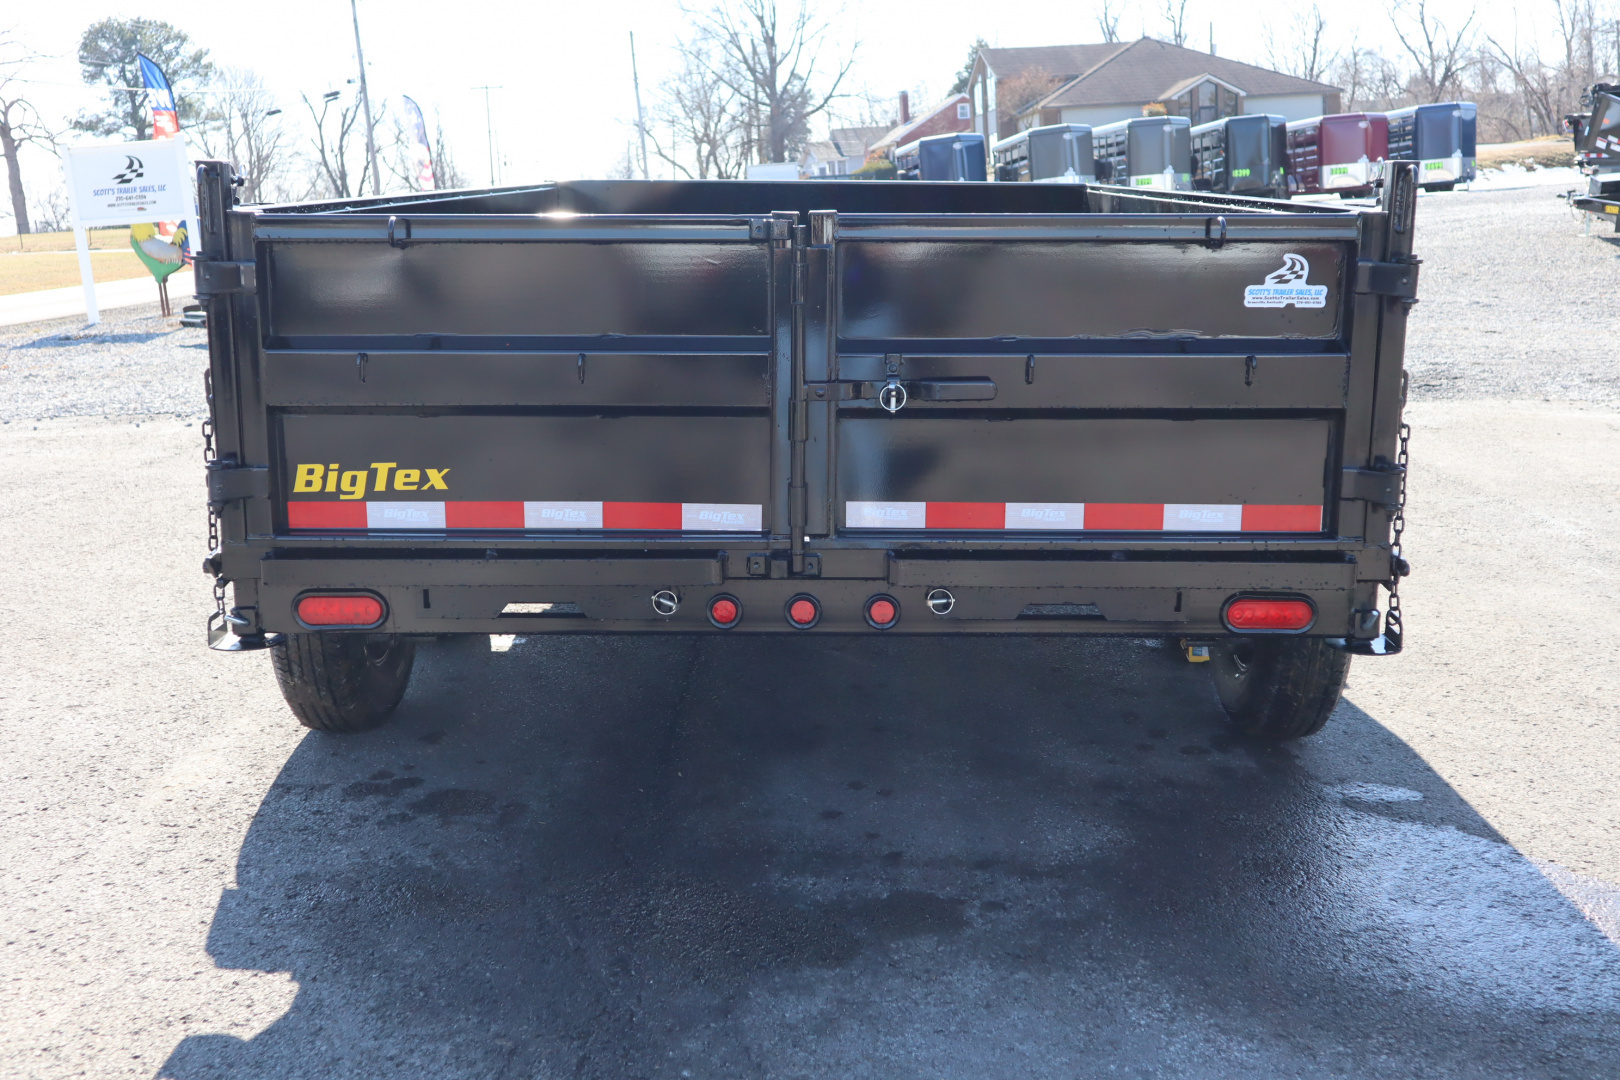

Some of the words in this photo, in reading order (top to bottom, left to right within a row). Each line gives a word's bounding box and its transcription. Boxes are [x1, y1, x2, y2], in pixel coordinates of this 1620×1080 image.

[93, 188, 115, 196] SCOTT'S
[116, 186, 137, 194] TRAILER
[138, 185, 156, 193] SALES,
[293, 462, 450, 500] BigTex
[384, 509, 428, 520] BigTex
[542, 508, 586, 520] BigTex
[700, 510, 744, 522] BigTex
[1022, 508, 1066, 520] BigTex
[1180, 510, 1224, 520] BigTex
